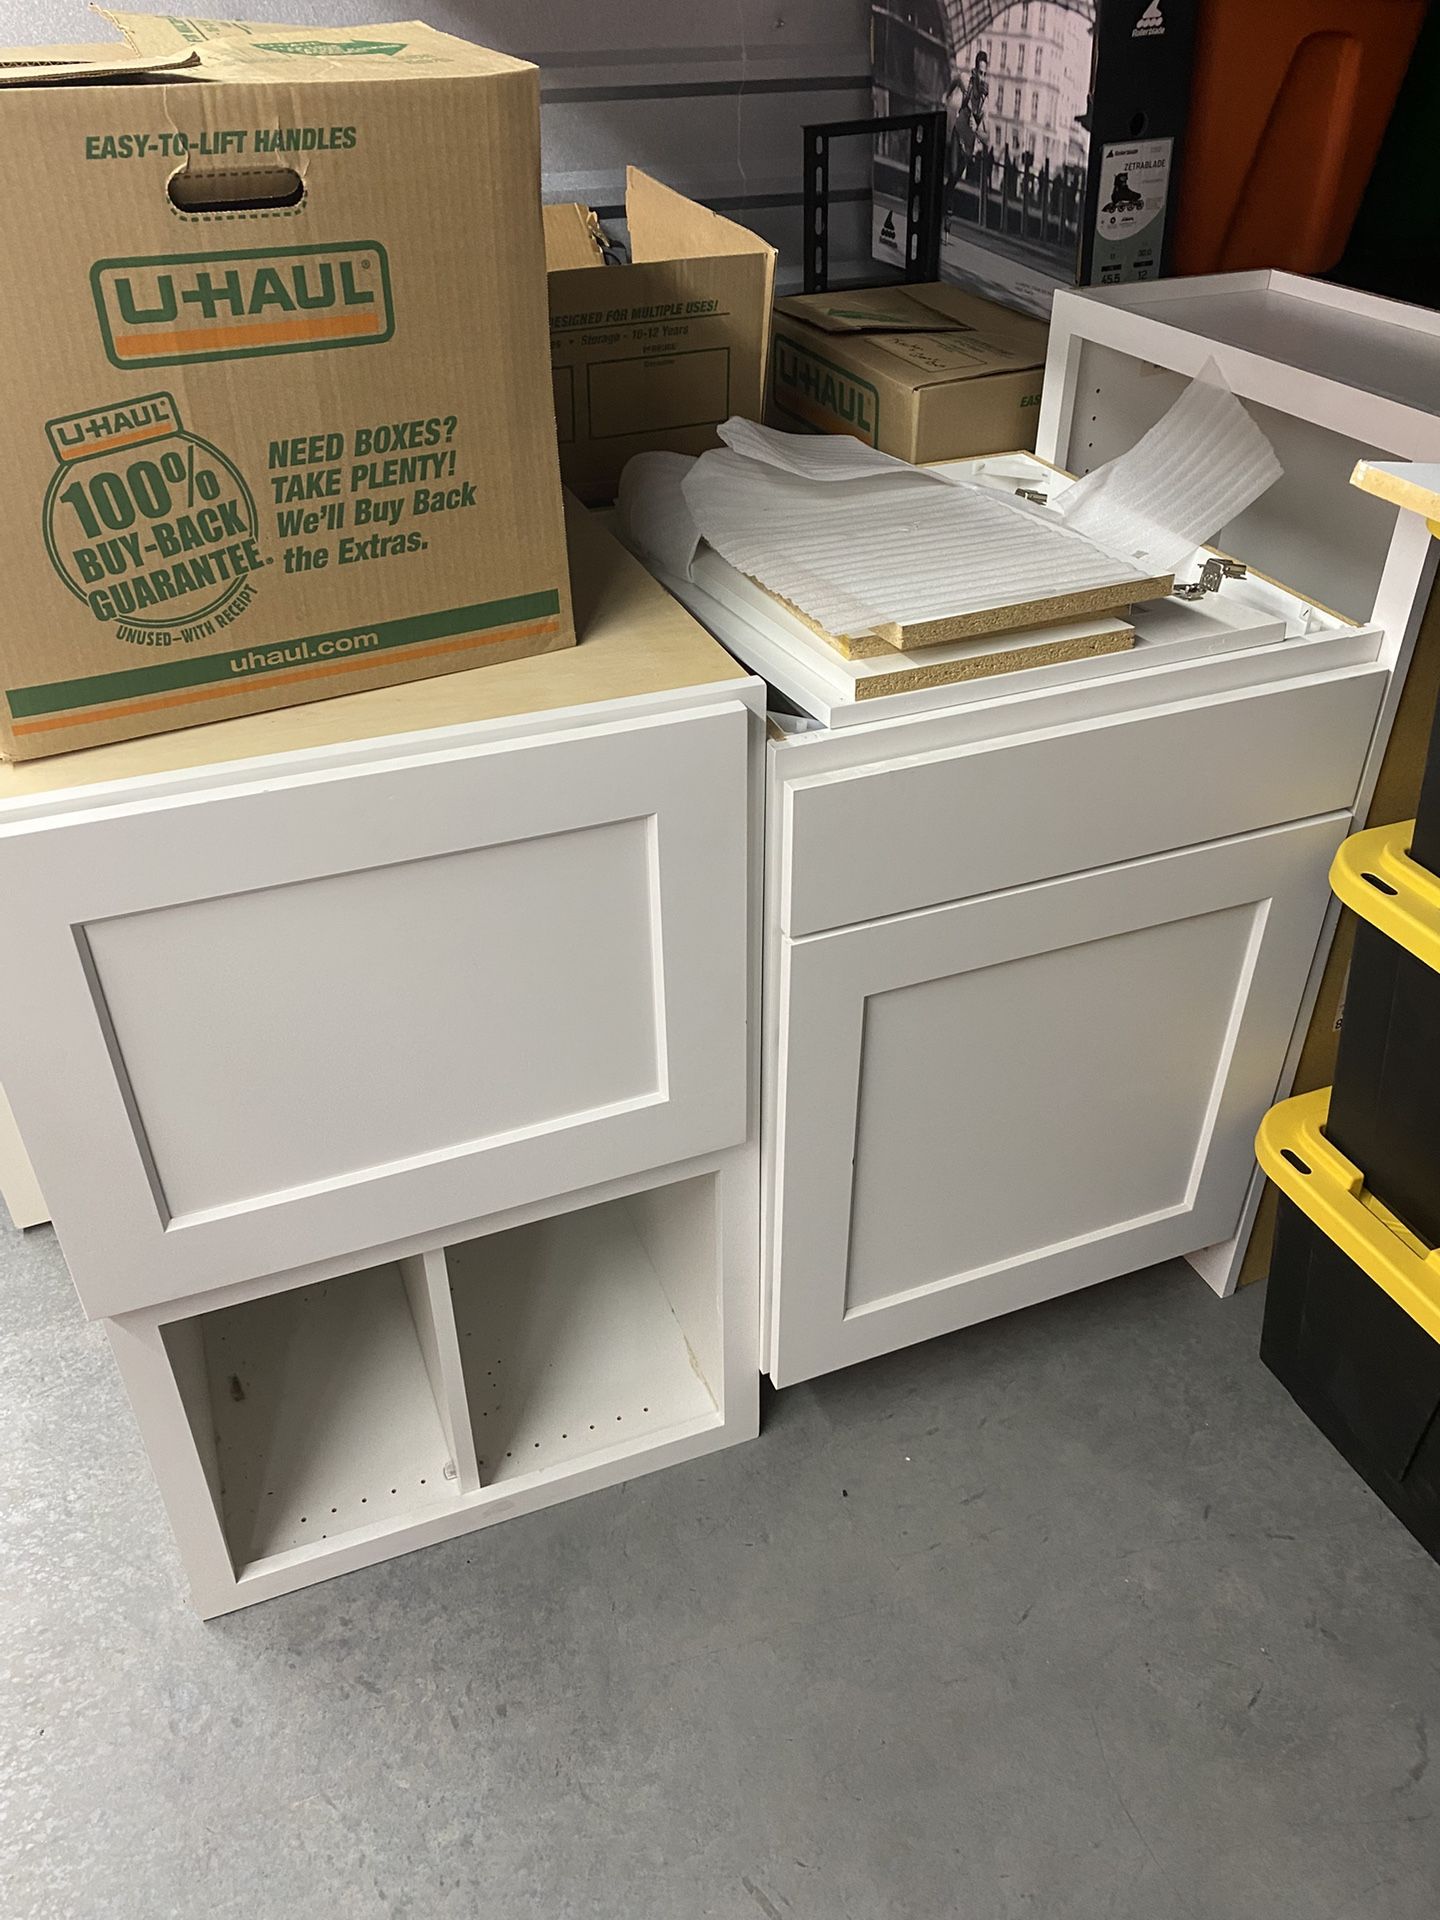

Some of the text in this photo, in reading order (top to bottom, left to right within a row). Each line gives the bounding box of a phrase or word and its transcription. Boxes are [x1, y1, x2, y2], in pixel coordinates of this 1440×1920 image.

[85, 126, 357, 160] EASY-TO-LIFT HANDLES
[606, 308, 629, 323] FOR
[631, 302, 684, 320] MULTIPLE
[686, 300, 719, 314] USES!
[268, 415, 458, 469] NEED BOXES?
[59, 444, 221, 539] 100%
[271, 449, 457, 504] TAKE PLENTY!
[277, 481, 478, 538] We'll Buy Back
[72, 499, 248, 585] BUY-BACK
[283, 531, 429, 574] the Extras.
[214, 583, 259, 629] RECEIPT
[229, 631, 379, 673] uhaul.com
